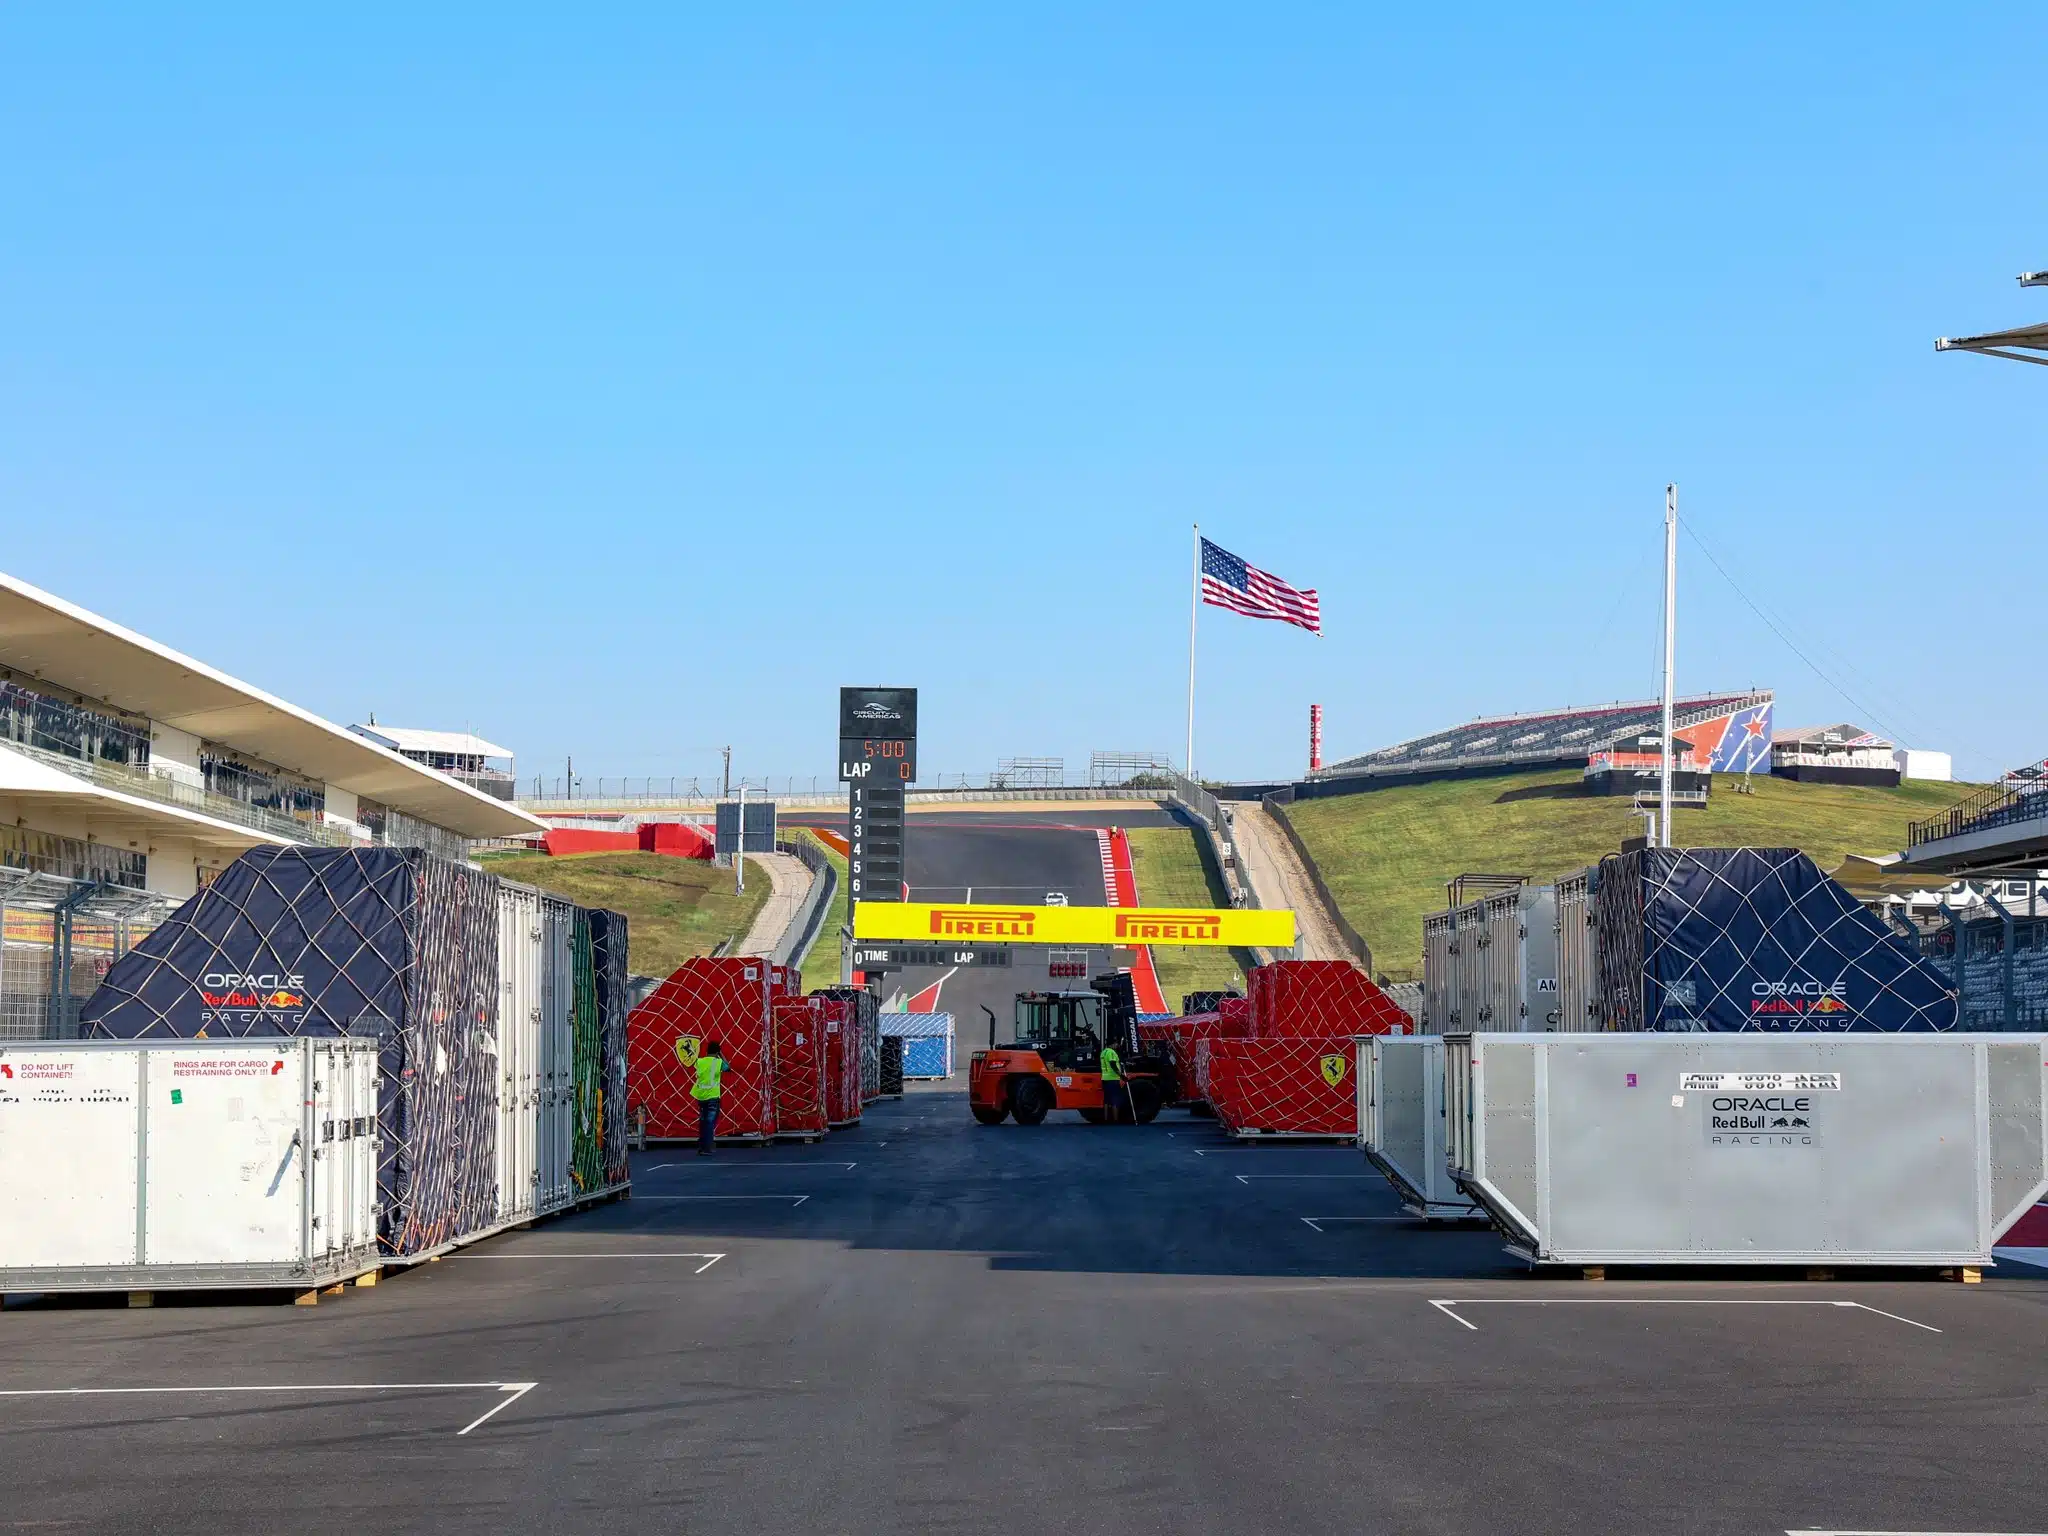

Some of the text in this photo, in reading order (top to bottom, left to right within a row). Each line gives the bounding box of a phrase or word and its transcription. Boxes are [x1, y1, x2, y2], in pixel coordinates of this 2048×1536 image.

[864, 741, 905, 758] 5:00
[843, 762, 871, 778] LAP
[900, 762, 910, 779] 0
[854, 789, 861, 801] 1
[854, 807, 862, 819] 2
[853, 825, 862, 837] 3
[853, 843, 861, 856] 4
[853, 862, 861, 874] 5
[852, 880, 861, 892] 6
[930, 910, 1036, 936] PIRELLI
[1115, 914, 1221, 940] PIRELLI
[864, 950, 889, 962] TIME
[954, 952, 974, 964] LAP
[203, 973, 305, 989] ORACLE
[1752, 981, 1847, 996] ORACLE
[1751, 999, 1803, 1013] Red Bull
[1751, 1019, 1849, 1028] RACING
[1129, 1016, 1139, 1053] DOOSAN
[21, 1063, 75, 1071] DO NOT LIFT
[219, 1060, 237, 1068] FOR
[238, 1060, 268, 1068] CARGO
[173, 1069, 232, 1077] RESTRAINING
[1712, 1097, 1810, 1112] ORACLE
[1712, 1115, 1765, 1129] Red Bull
[1712, 1136, 1812, 1145] RACING
